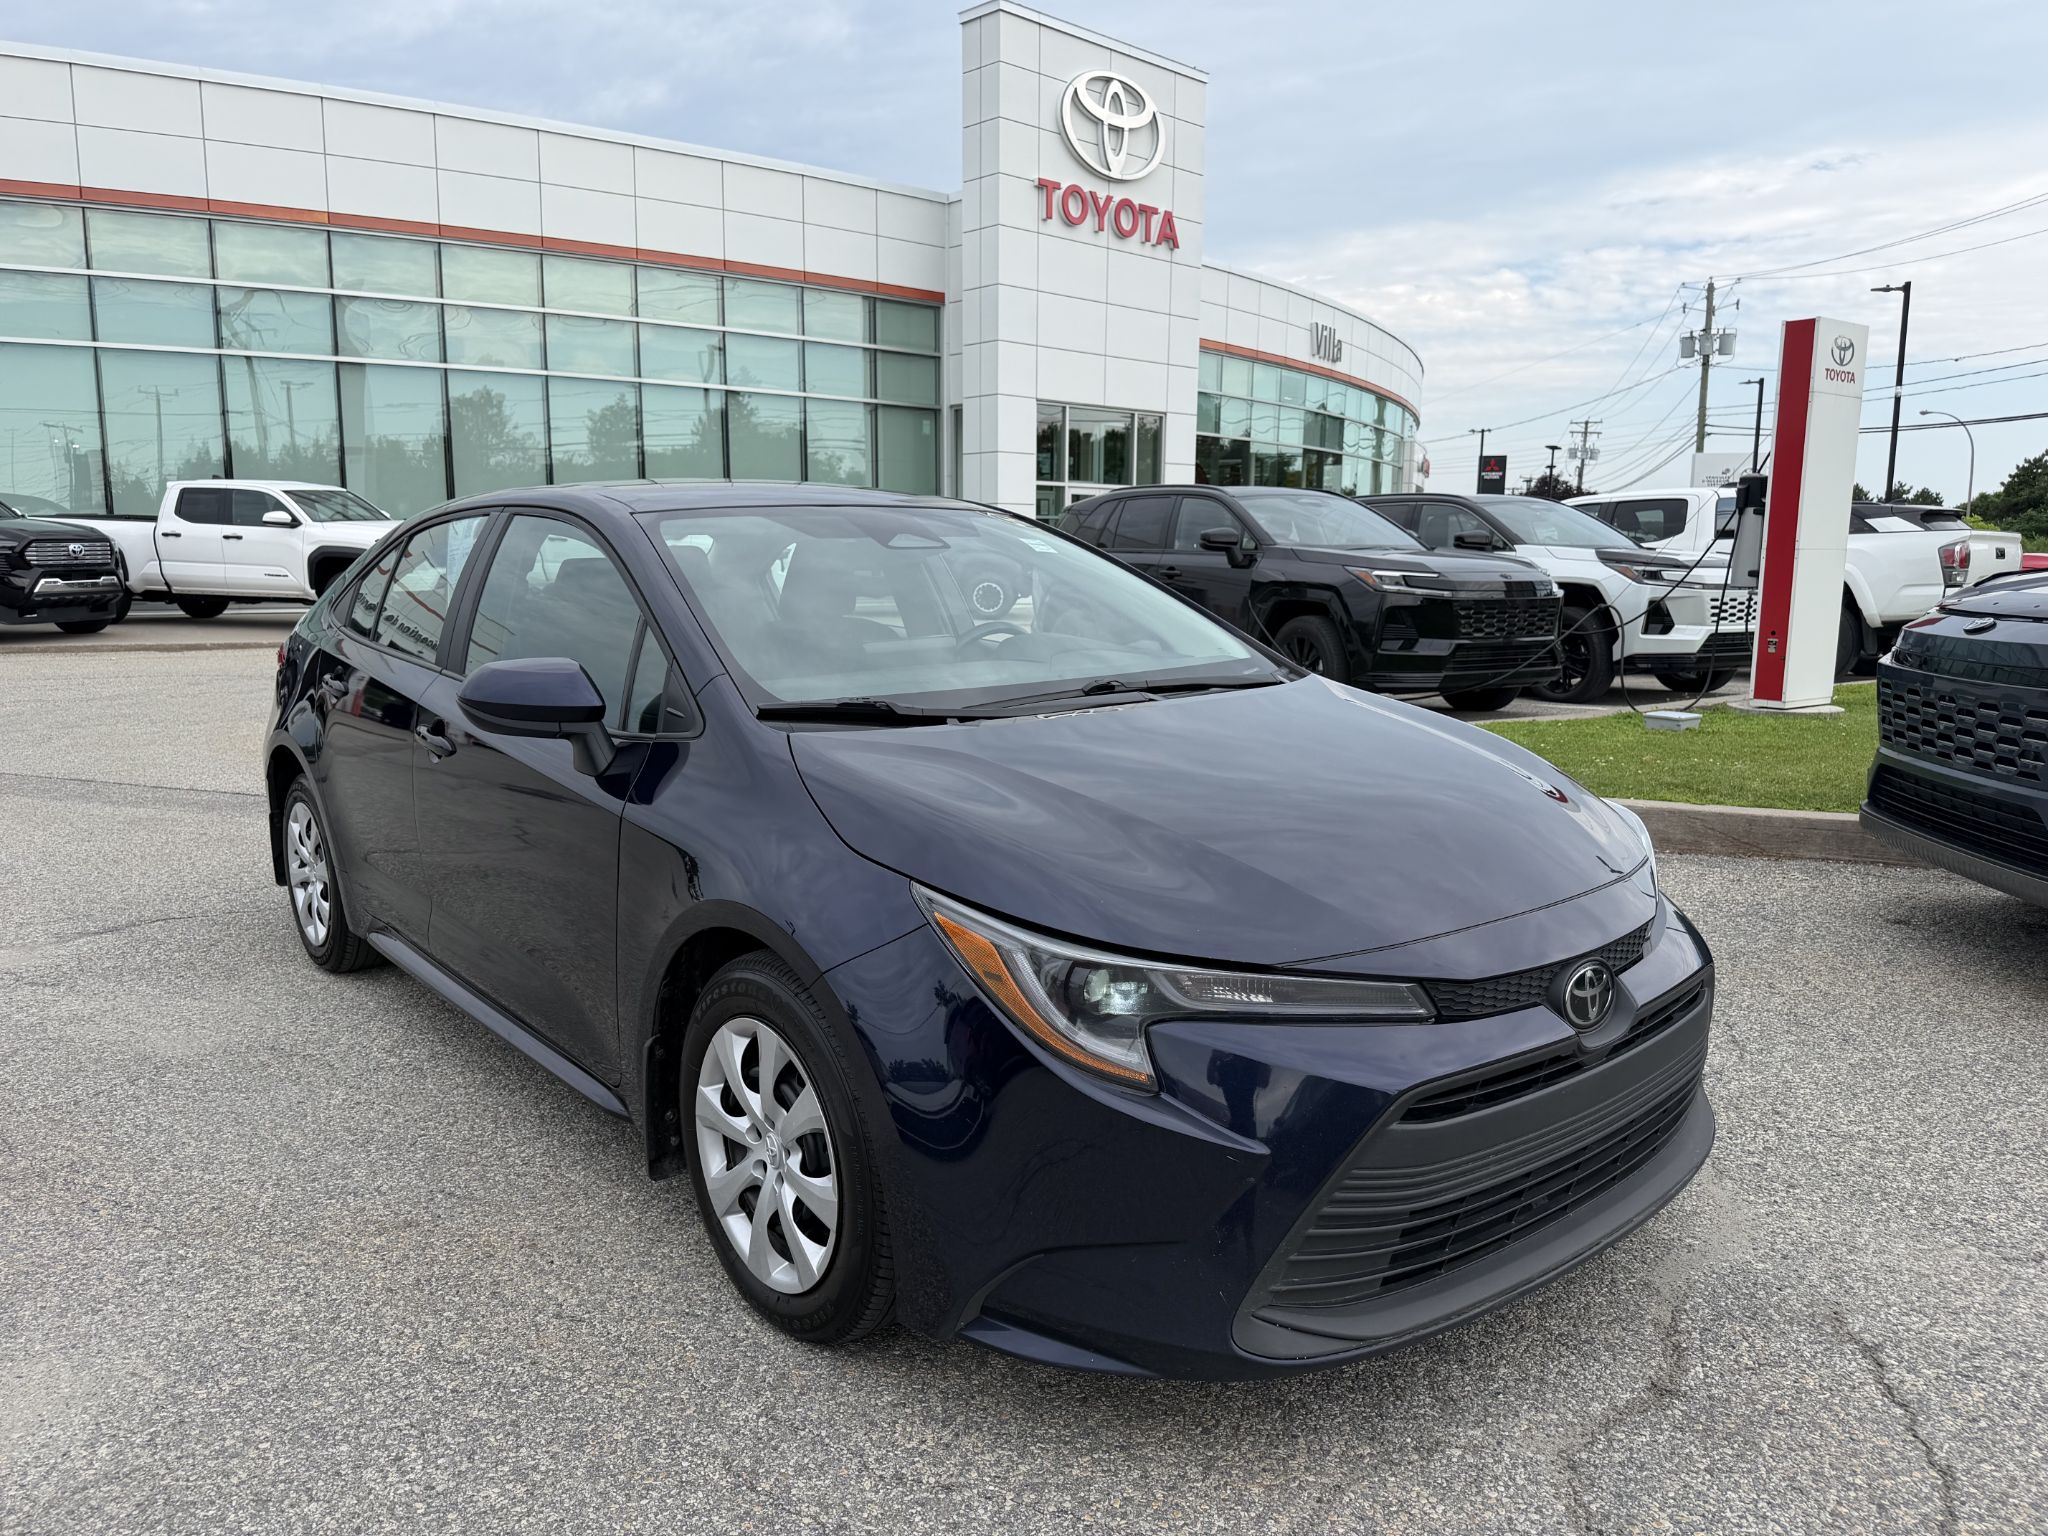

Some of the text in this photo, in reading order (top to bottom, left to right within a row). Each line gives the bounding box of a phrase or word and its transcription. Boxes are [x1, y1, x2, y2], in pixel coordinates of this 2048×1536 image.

[1035, 177, 1180, 250] TOYOTA
[1311, 321, 1343, 363] Villa
[1825, 367, 1856, 384] TOYOTA
[695, 982, 761, 1021] Fireston
